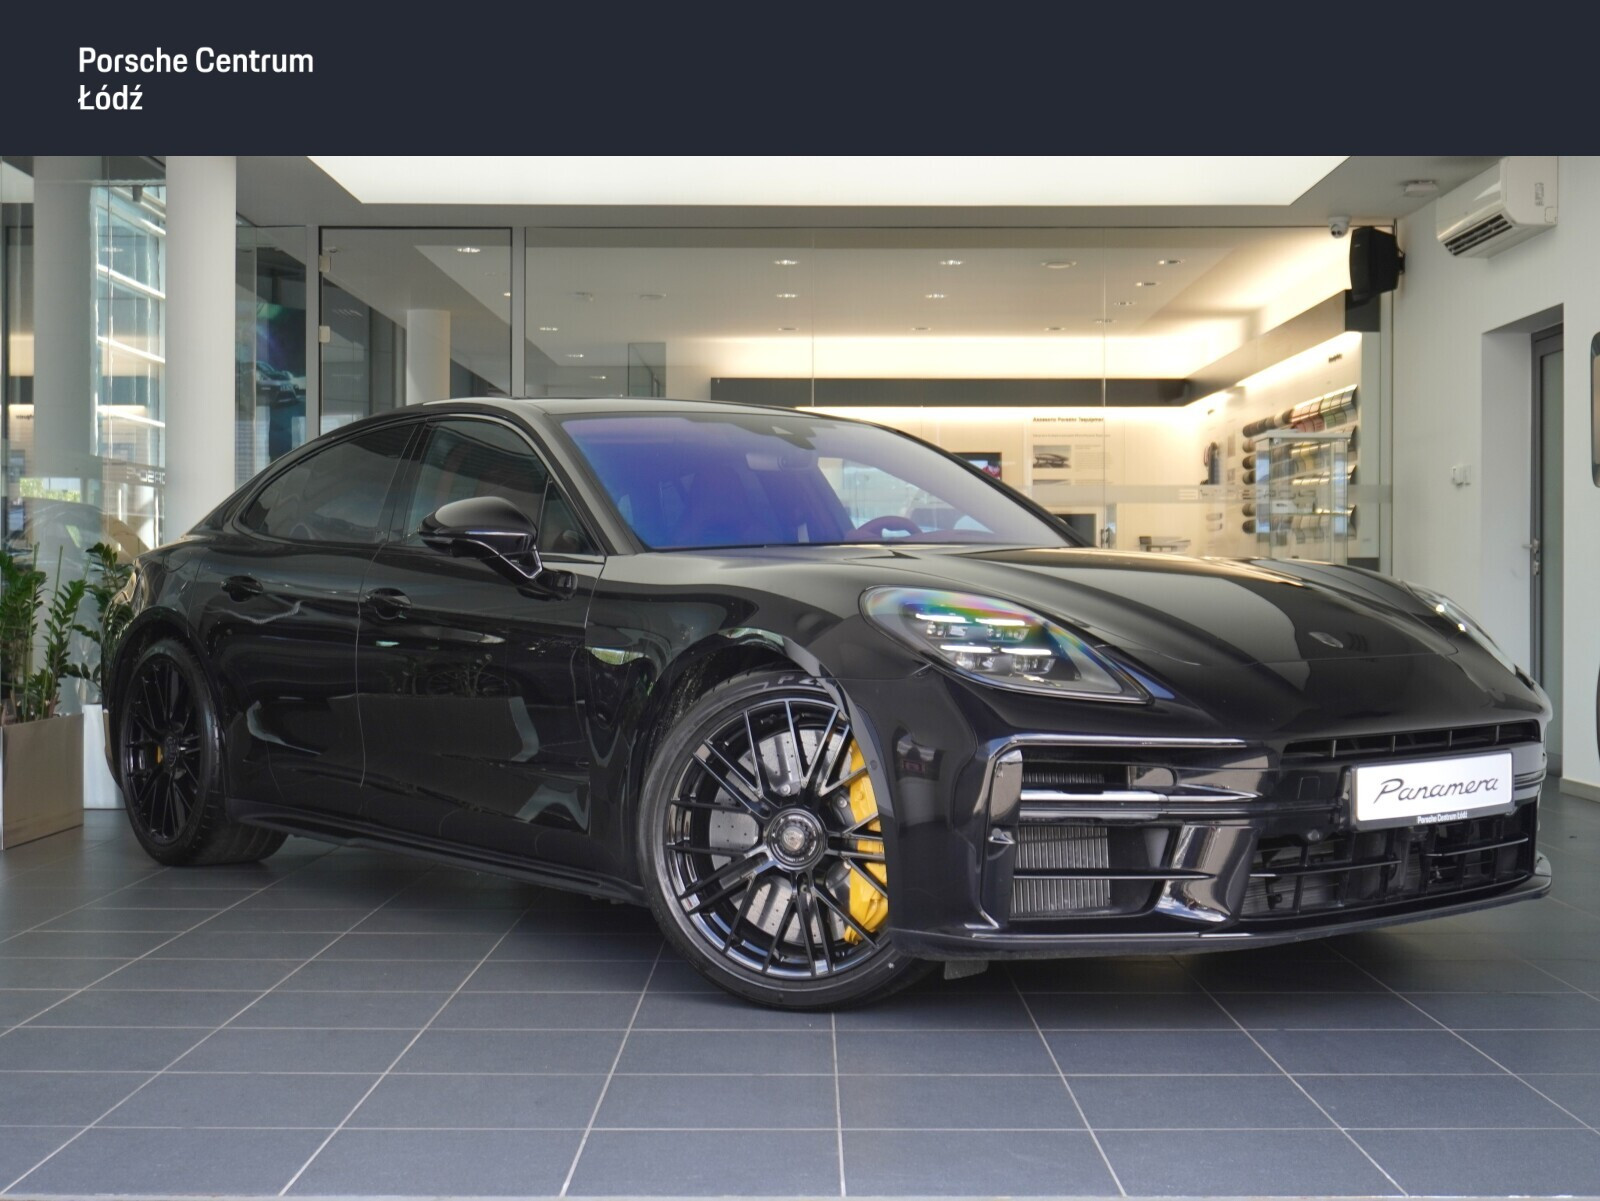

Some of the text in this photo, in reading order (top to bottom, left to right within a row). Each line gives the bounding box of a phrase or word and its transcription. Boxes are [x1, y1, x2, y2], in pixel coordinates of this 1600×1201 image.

[1373, 777, 1499, 804] Panamera
[1417, 814, 1437, 824] Porsche
[1437, 812, 1457, 822] Centrum
